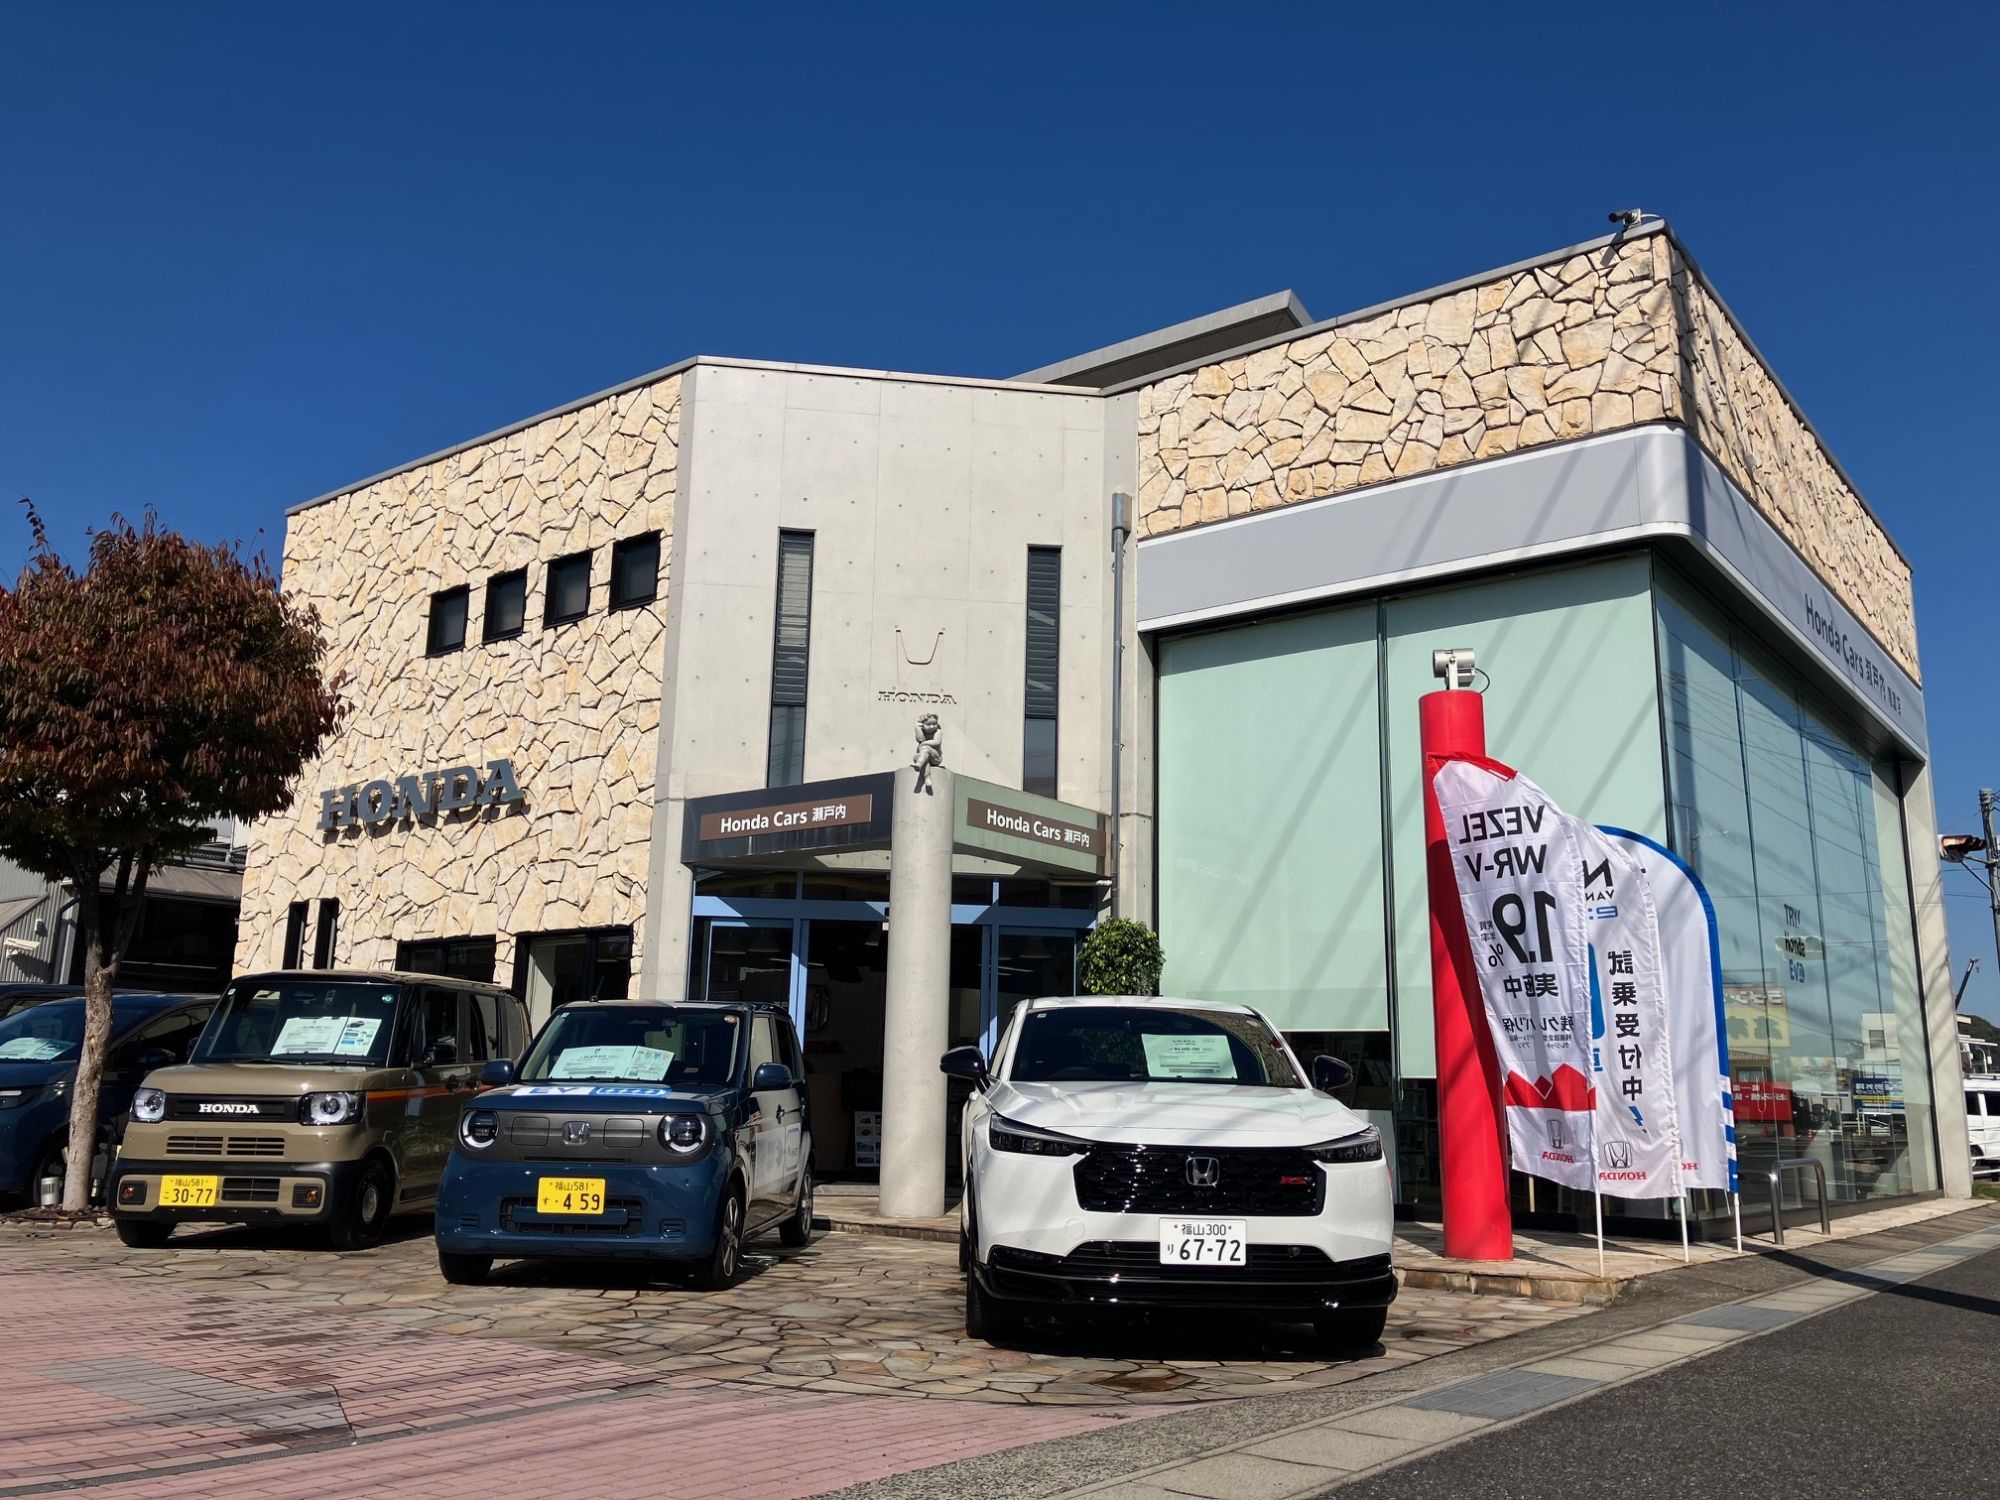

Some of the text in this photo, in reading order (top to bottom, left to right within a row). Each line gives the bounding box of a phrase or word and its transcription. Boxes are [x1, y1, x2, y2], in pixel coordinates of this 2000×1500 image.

[1805, 593, 1840, 656] Honda
[1842, 634, 1864, 680] Cars
[878, 690, 957, 705] HONDA
[317, 758, 524, 829] HONDA
[720, 804, 846, 833] Honda Cars 瀬戸内
[987, 808, 1090, 848] Honda Cars 瀬戸内
[1784, 903, 1801, 928] TRY!
[1784, 930, 1806, 957] Honda
[198, 1103, 260, 1114] HONDA
[172, 1188, 213, 1204] 30-77
[1179, 1238, 1241, 1262] 67-72
